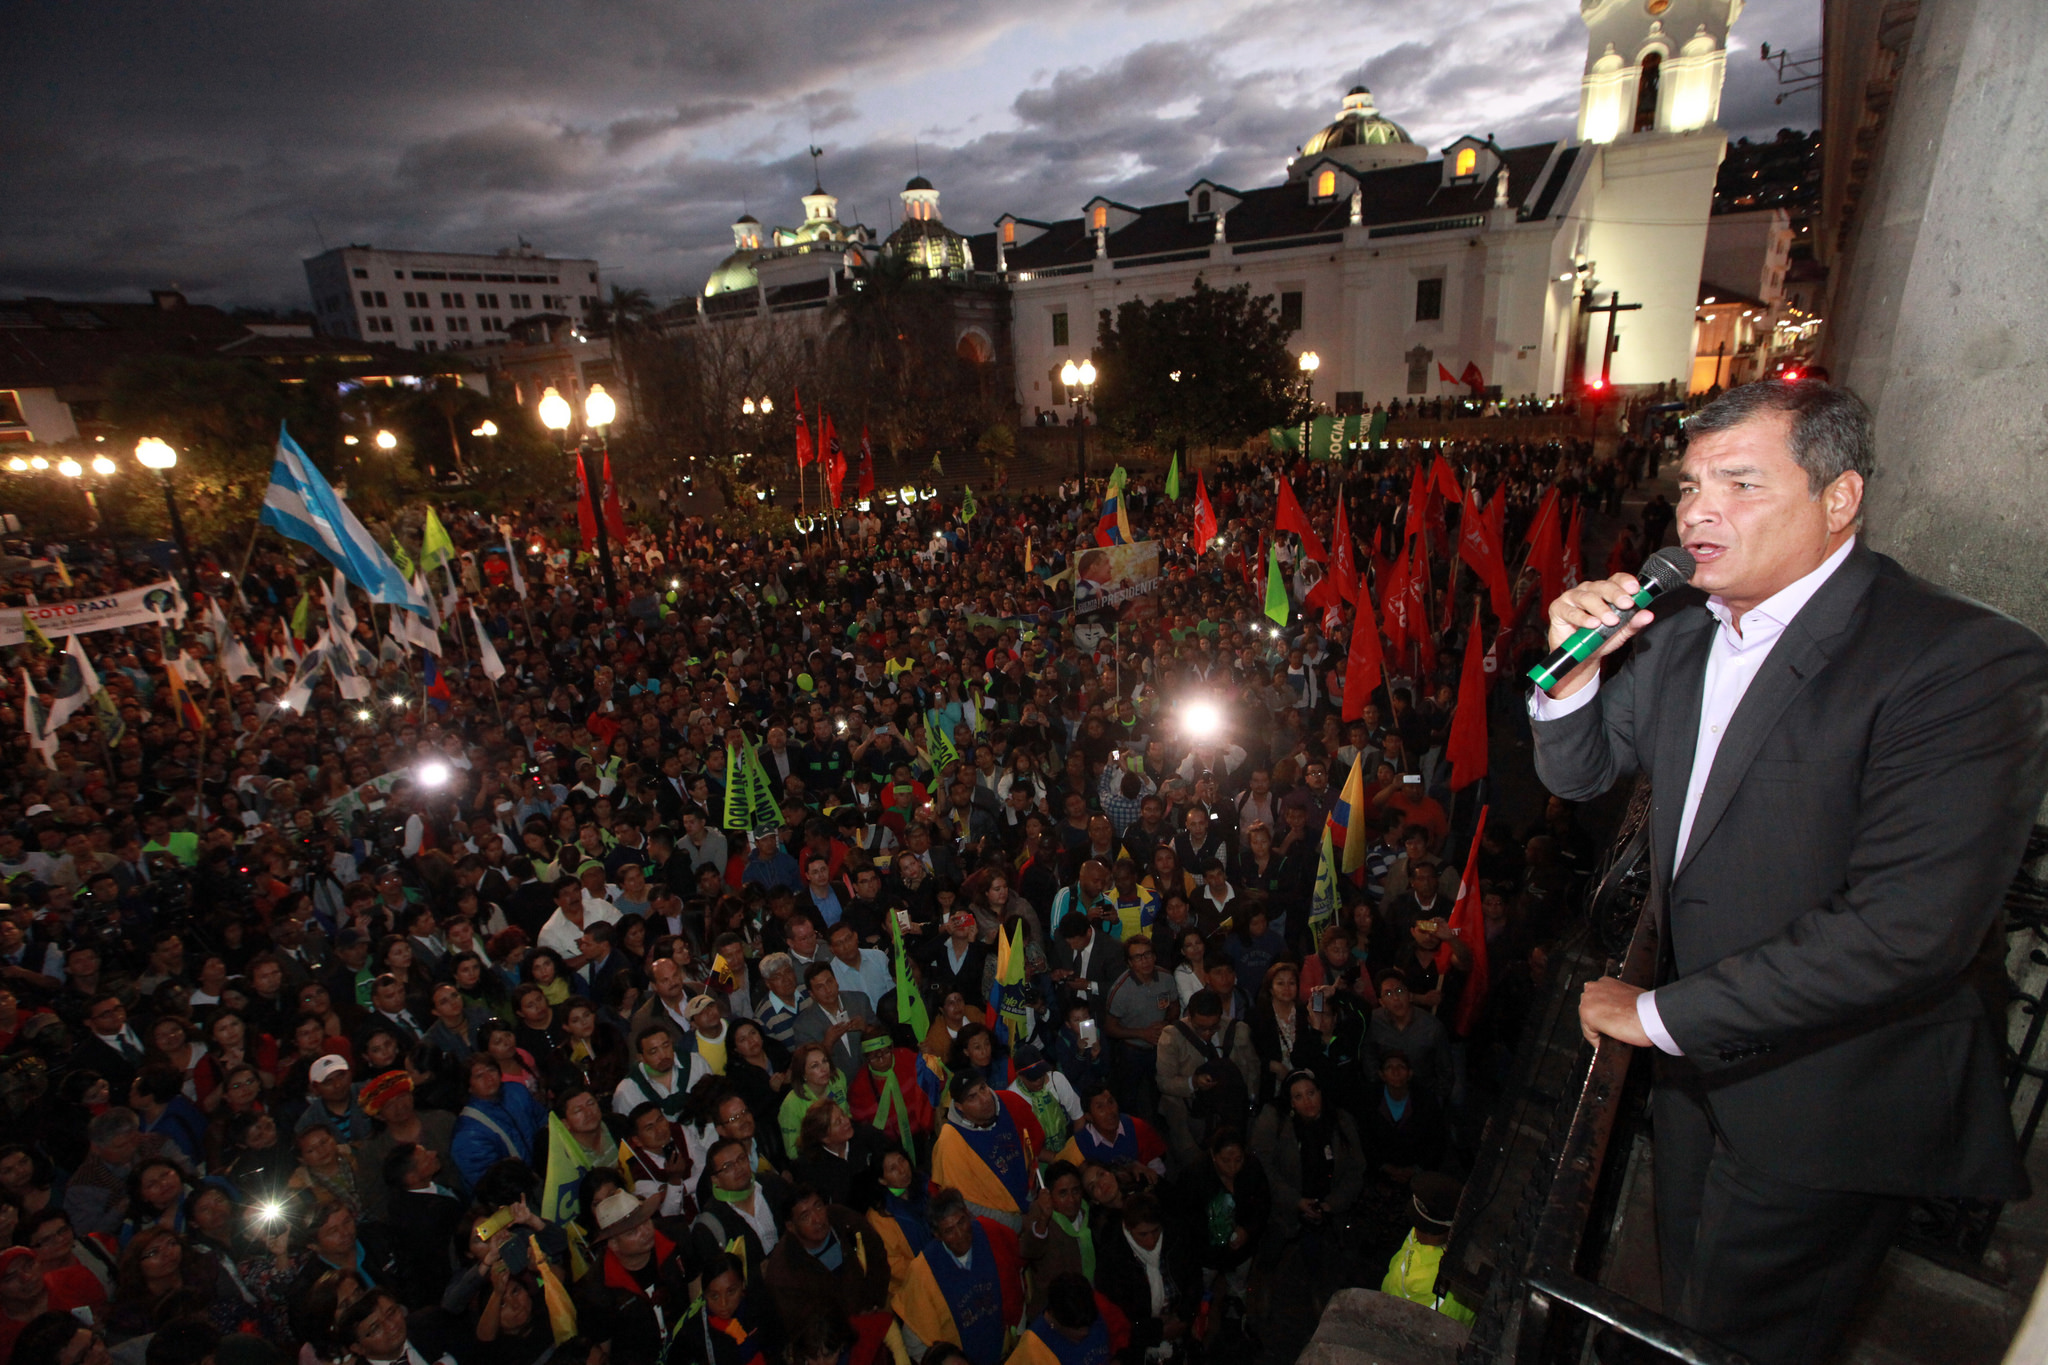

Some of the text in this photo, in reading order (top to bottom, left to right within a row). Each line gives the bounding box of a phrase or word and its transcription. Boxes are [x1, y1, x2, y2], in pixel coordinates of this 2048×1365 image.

[1329, 417, 1346, 460] SOCIAL
[1101, 579, 1158, 607] PRESIDENTE
[26, 598, 118, 620] COTOPAXI
